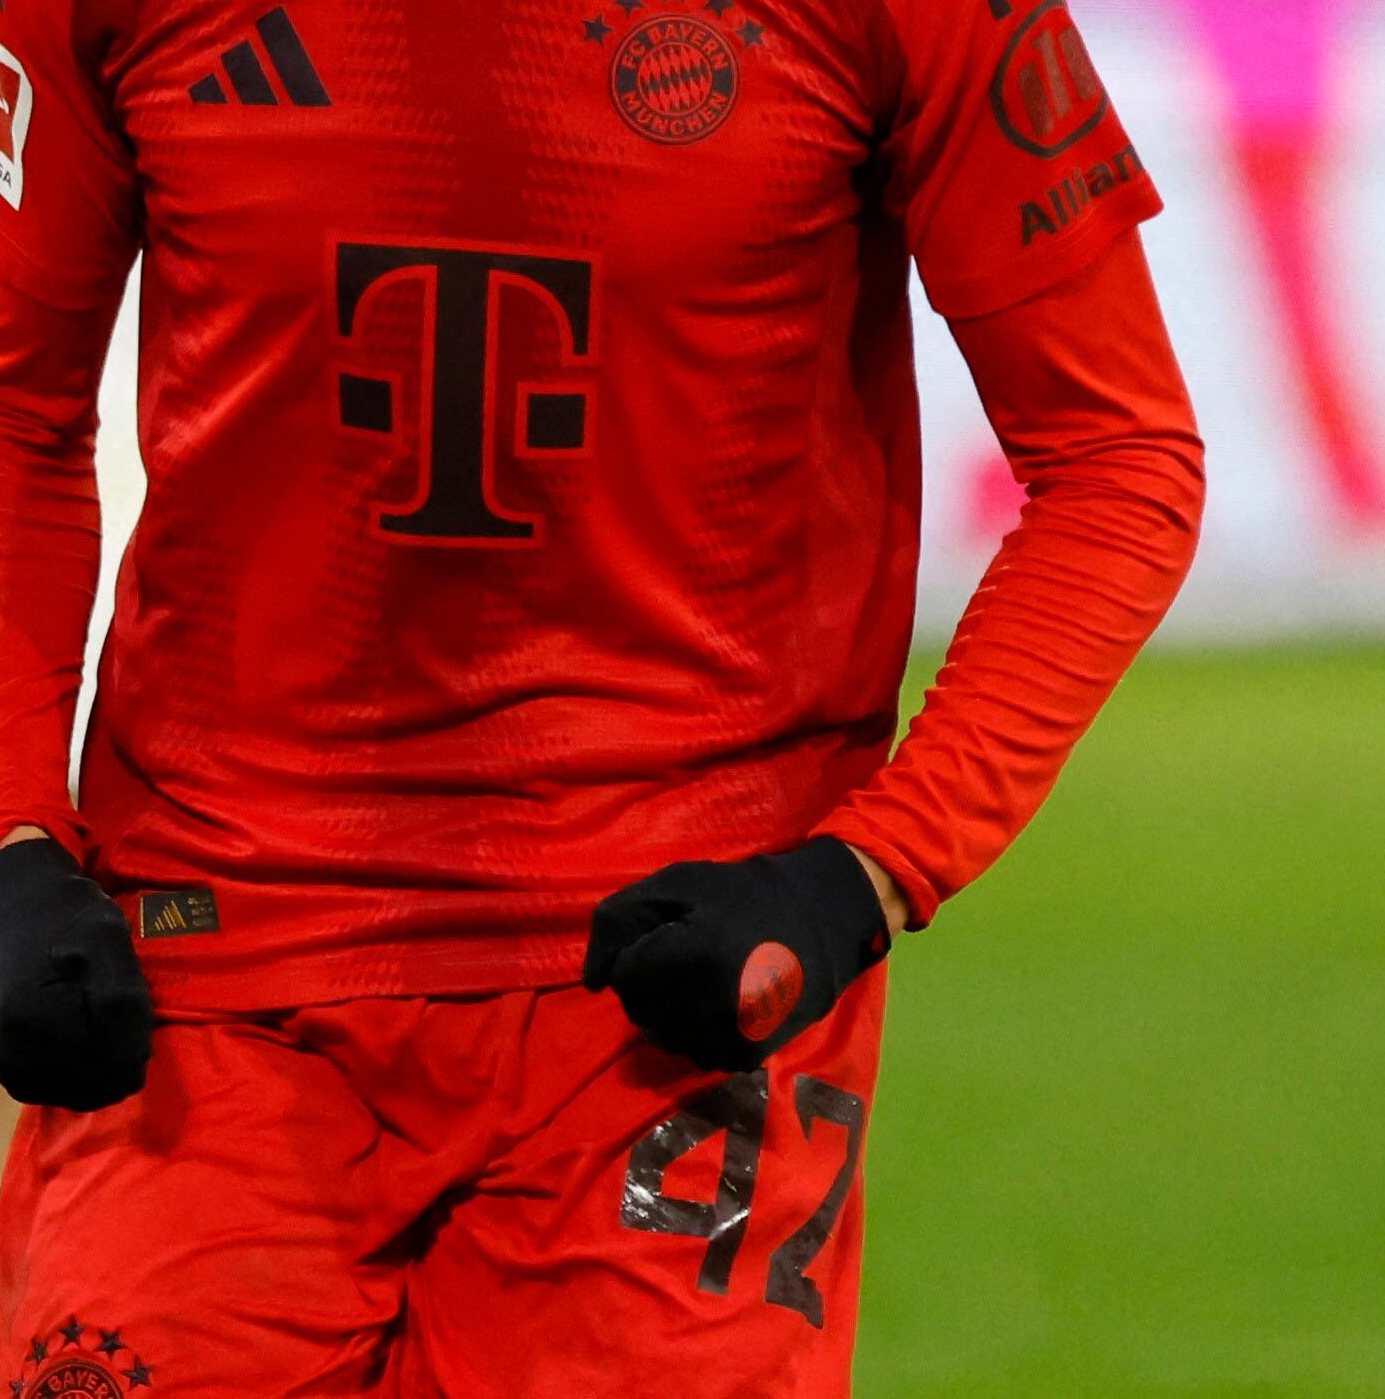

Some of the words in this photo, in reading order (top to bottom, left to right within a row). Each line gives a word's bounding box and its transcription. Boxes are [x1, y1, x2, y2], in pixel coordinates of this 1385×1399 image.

[646, 23, 729, 71] BAYERN
[1019, 144, 1145, 247] Allian
[335, 241, 593, 540] T
[46, 1369, 116, 1399] BAYER
